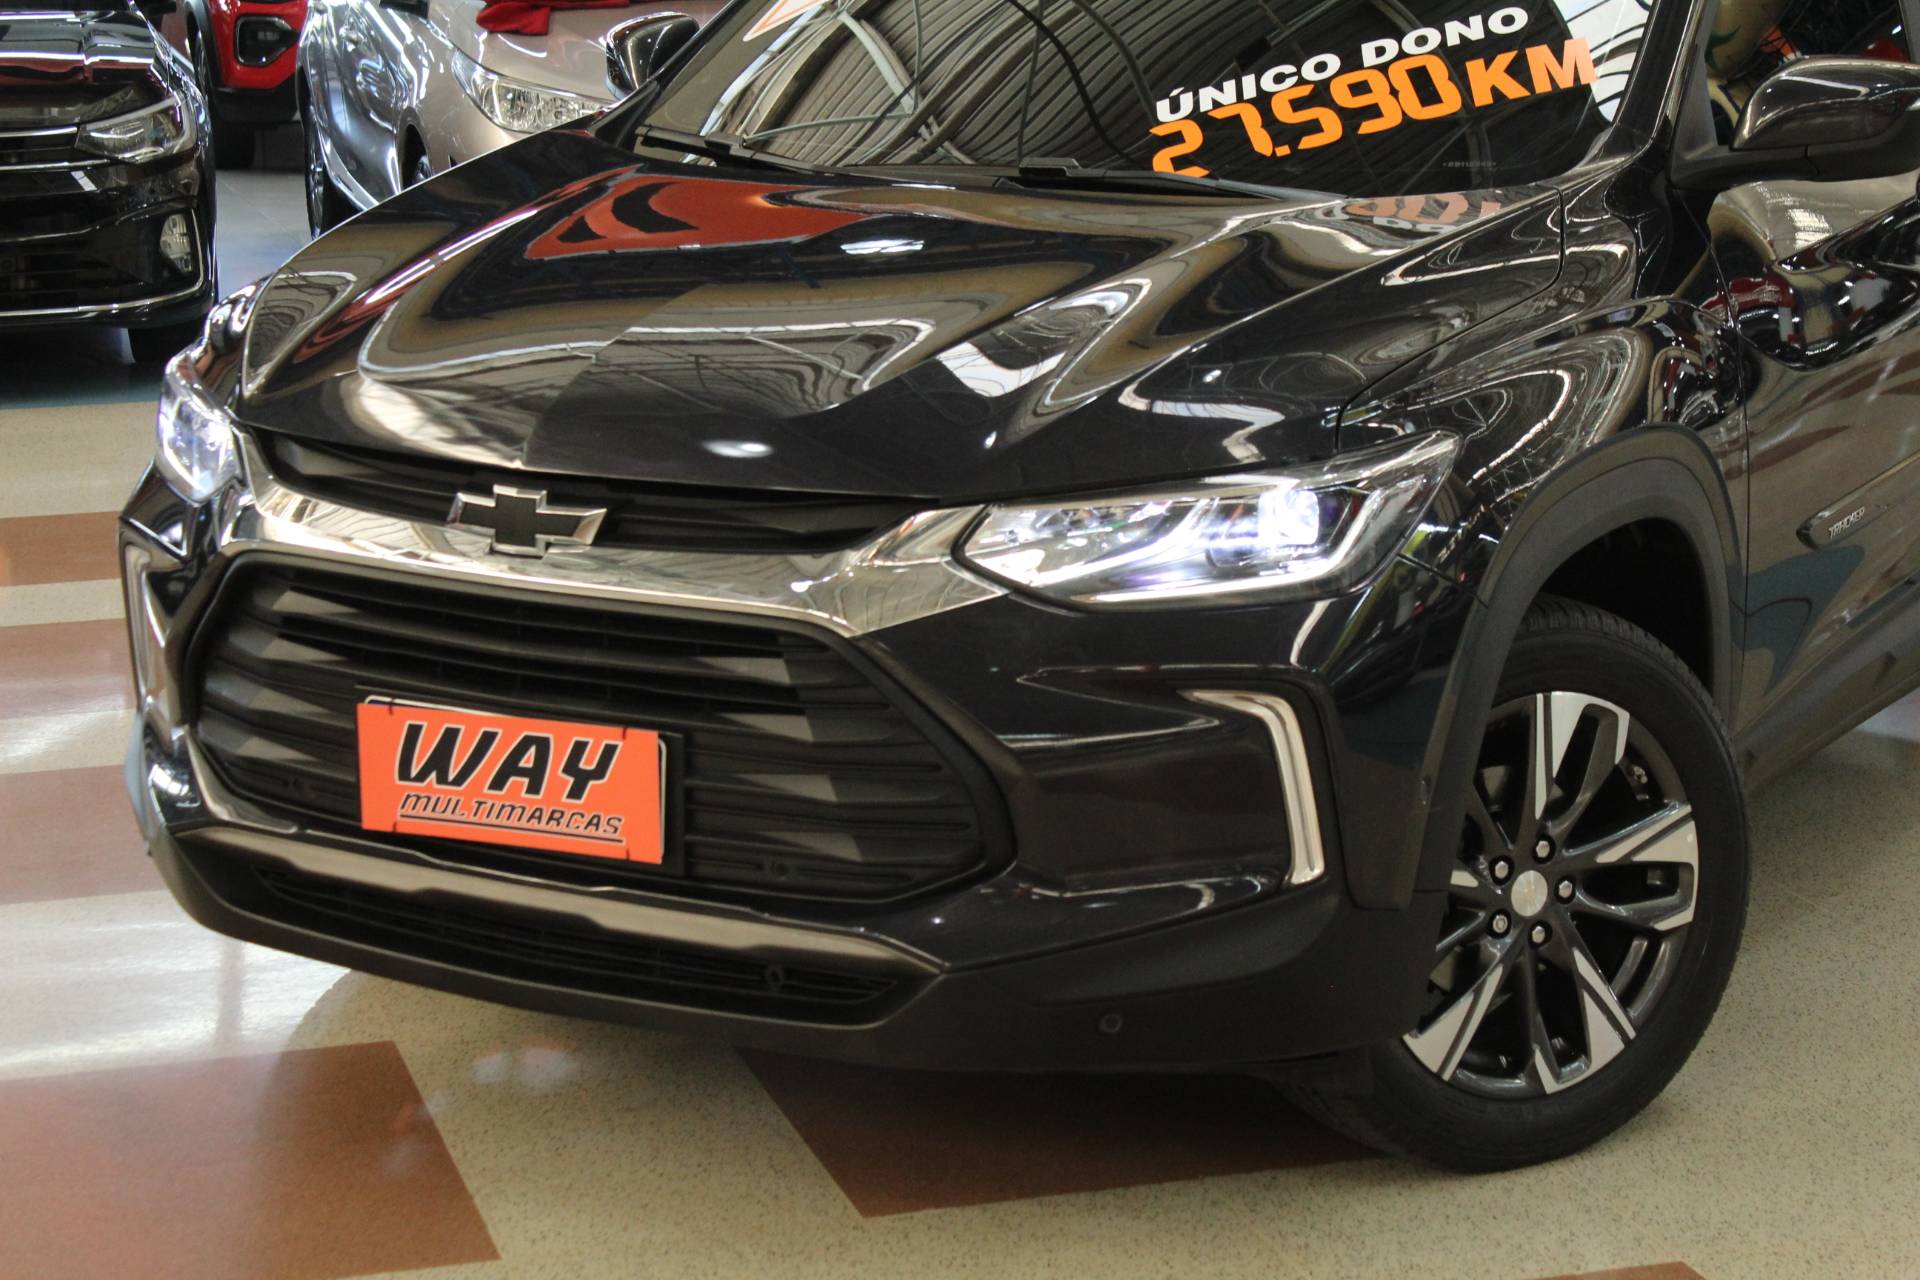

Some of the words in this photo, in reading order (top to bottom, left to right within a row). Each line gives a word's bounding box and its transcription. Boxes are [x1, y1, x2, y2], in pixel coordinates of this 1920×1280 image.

[1150, 54, 1462, 178] 27.590
[1464, 37, 1597, 107] KM
[1156, 53, 1341, 122] ÚNICO
[1361, 6, 1528, 67] DONO
[395, 721, 623, 803] WAY
[399, 791, 624, 835] MULTIMARCAS
